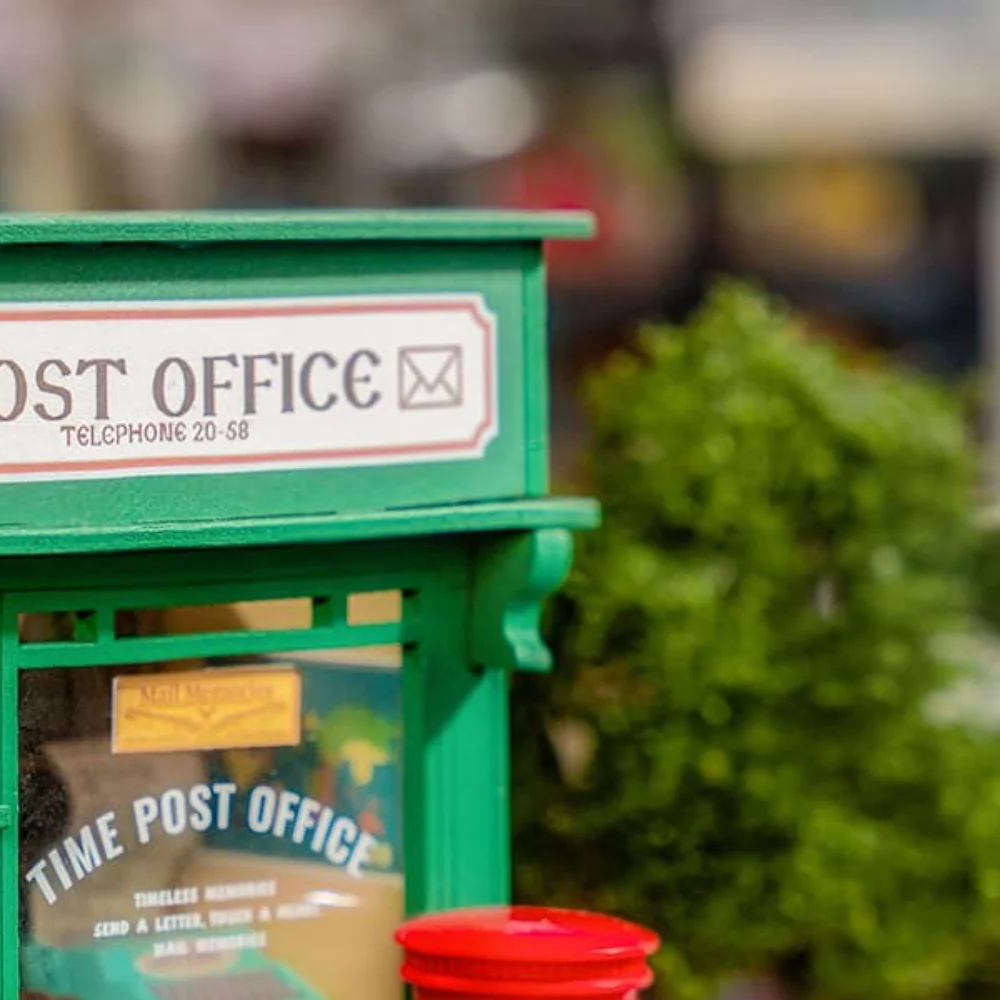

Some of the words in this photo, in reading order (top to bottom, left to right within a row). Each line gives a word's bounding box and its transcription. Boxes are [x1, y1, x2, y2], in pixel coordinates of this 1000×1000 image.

[152, 350, 382, 418] OFFICE
[61, 421, 187, 447] TELEPHONE
[193, 419, 249, 442] 20-58
[26, 811, 124, 905] TIME
[133, 782, 237, 844] POST
[248, 785, 379, 878] OFFICE
[133, 887, 199, 908] TIMELESS
[93, 920, 130, 938] SEND
[136, 918, 148, 934] A
[258, 906, 272, 921] A
